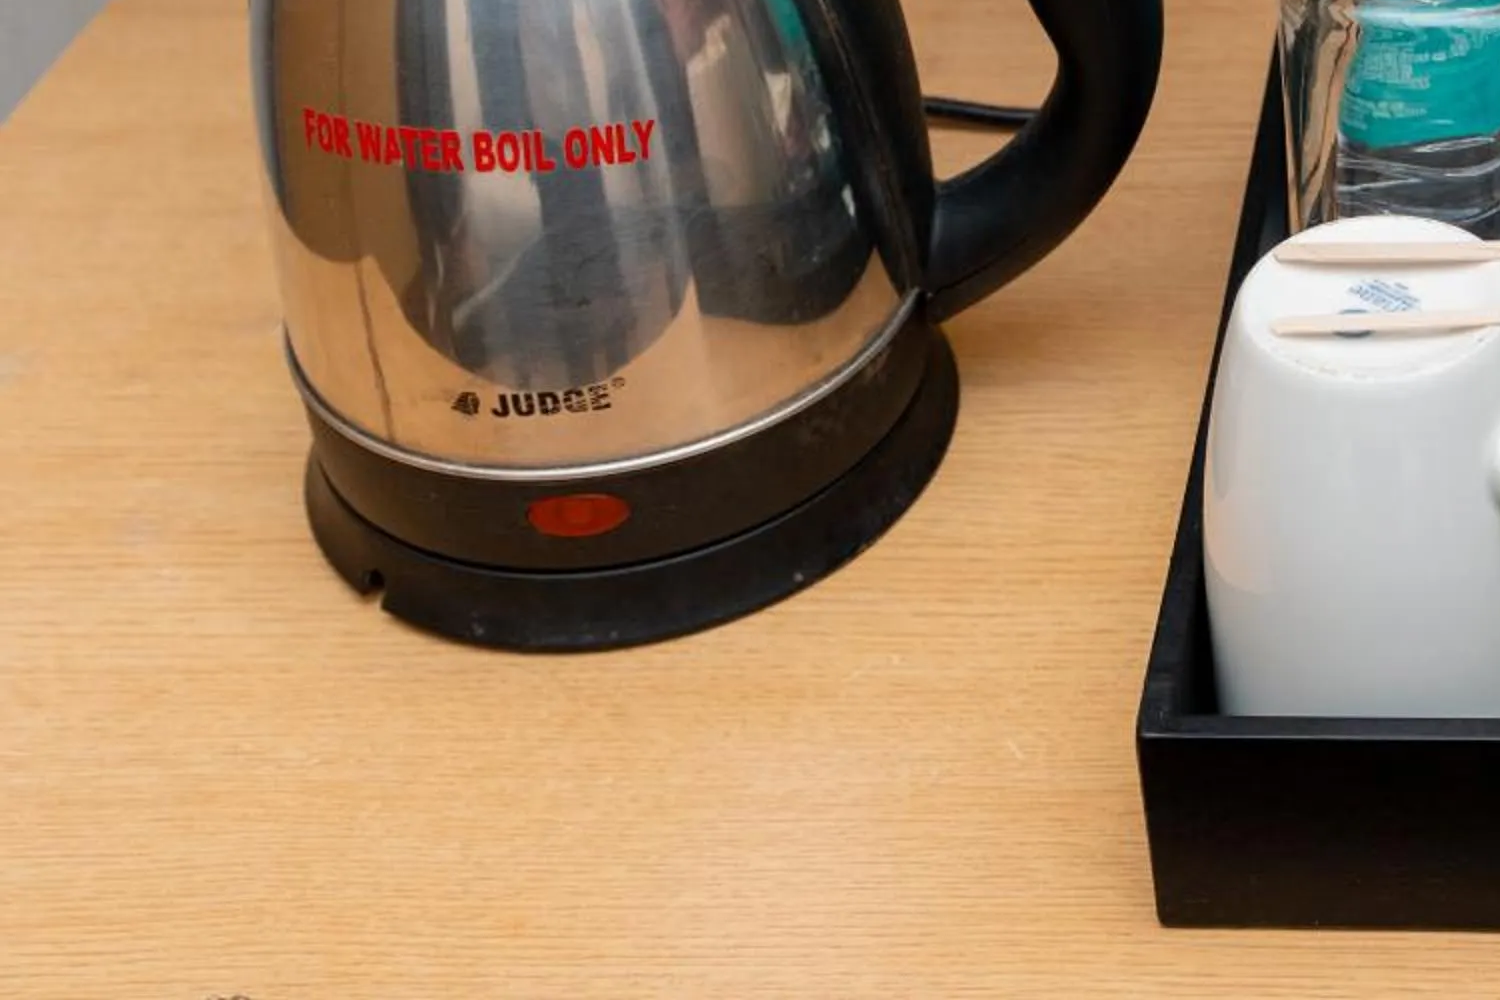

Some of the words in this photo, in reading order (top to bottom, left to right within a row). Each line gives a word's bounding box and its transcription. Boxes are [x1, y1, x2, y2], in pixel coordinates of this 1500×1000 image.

[303, 108, 353, 158] FOR
[356, 121, 464, 171] WATER
[472, 130, 555, 173] BOIL
[564, 119, 655, 169] ONLY
[491, 383, 612, 418] JUDGE
